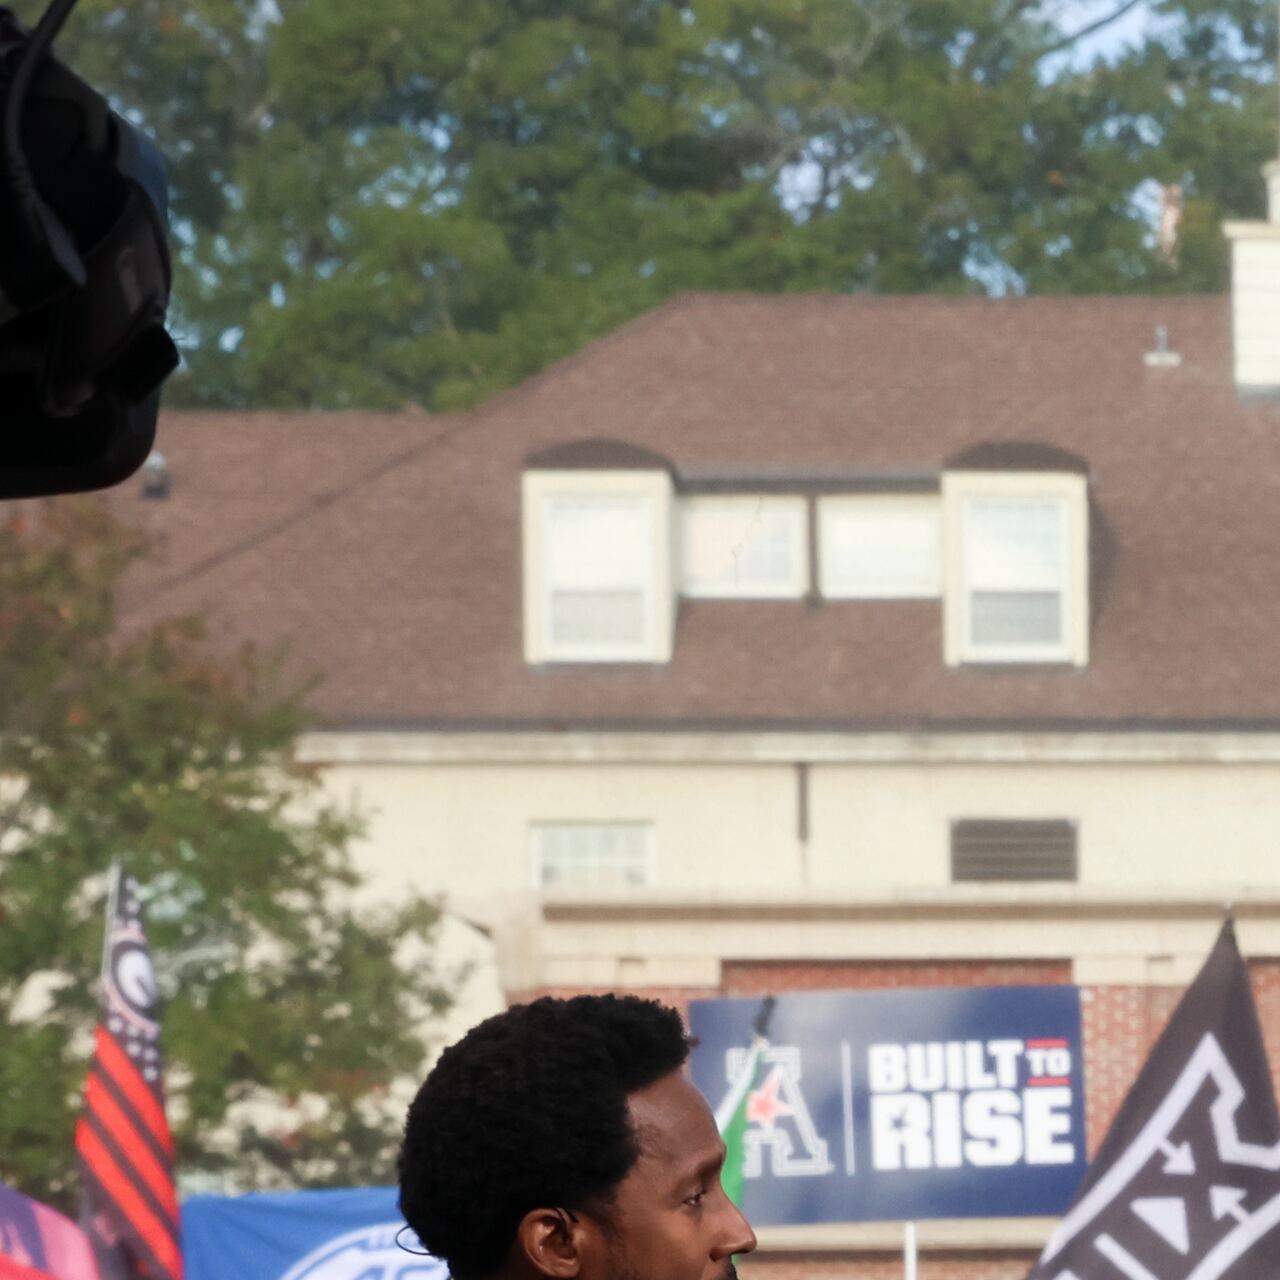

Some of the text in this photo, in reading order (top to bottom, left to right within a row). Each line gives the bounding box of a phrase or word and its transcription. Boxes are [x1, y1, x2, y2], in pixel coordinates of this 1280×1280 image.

[868, 1039, 1071, 1093] BUILT TO
[870, 1087, 1076, 1171] RISE
